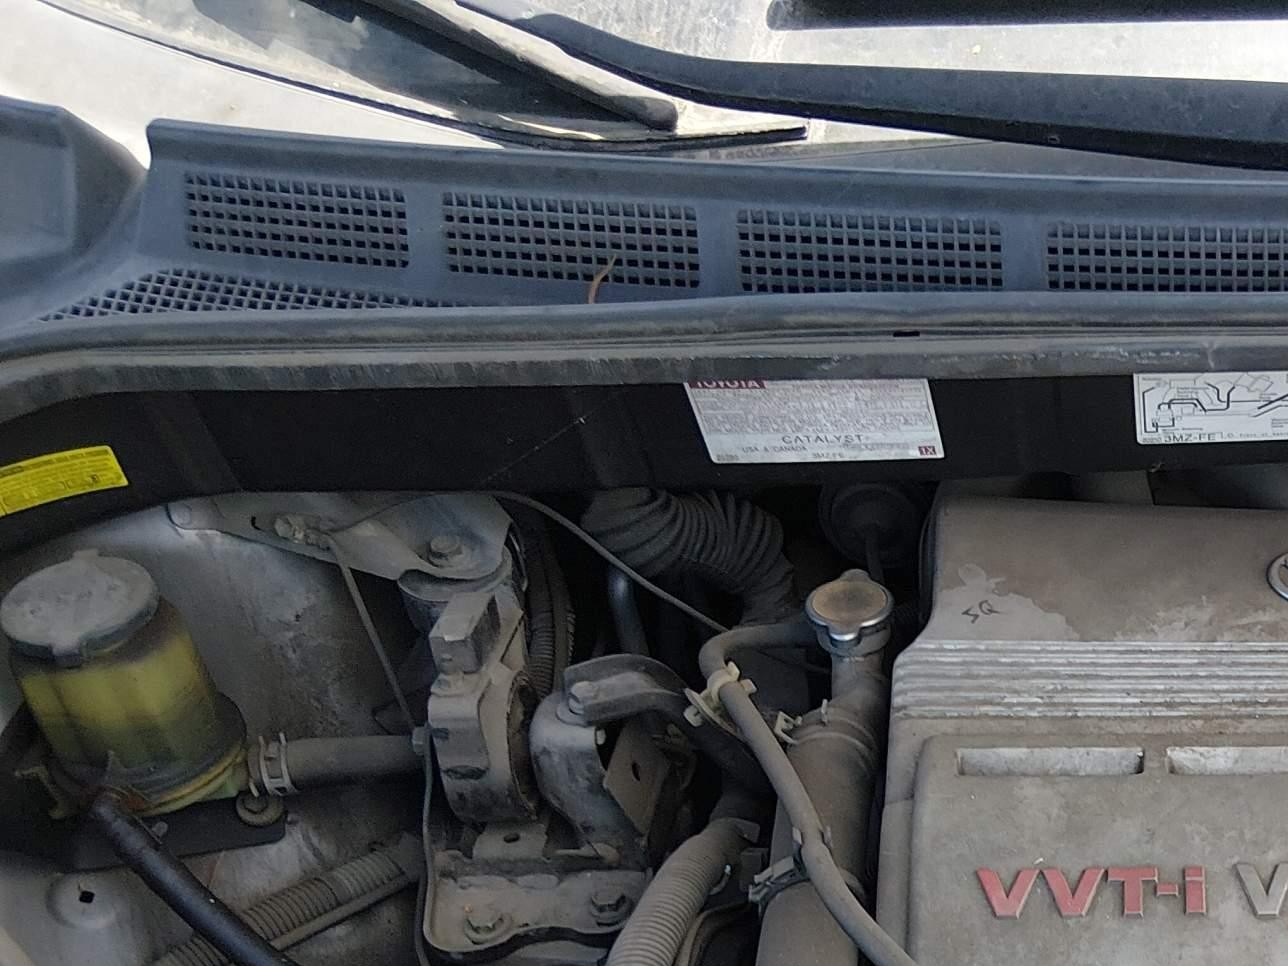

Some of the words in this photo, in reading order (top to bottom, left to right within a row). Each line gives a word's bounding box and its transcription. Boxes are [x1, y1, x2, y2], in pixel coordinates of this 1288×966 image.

[782, 434, 864, 445] CATALYST
[1164, 432, 1216, 443] 3MZ-FE
[773, 445, 807, 453] CANADA
[976, 866, 1207, 917] VVT-i
